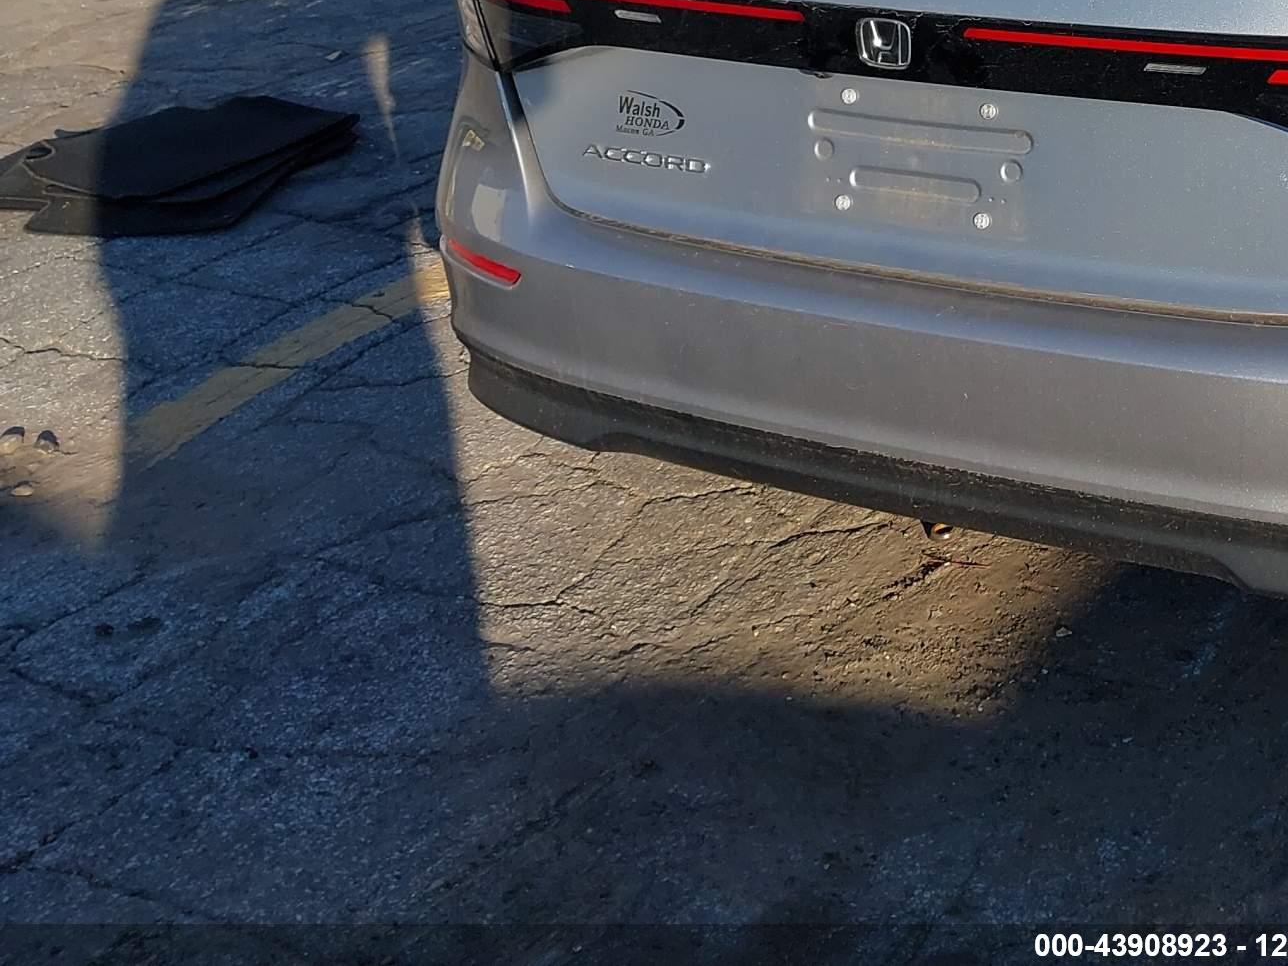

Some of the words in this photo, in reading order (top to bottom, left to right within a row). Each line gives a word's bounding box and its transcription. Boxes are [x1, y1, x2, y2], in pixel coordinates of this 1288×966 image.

[618, 95, 661, 118] Walsh
[625, 116, 670, 131] HONDA
[642, 127, 655, 137] GA
[582, 144, 709, 173] ACCORD
